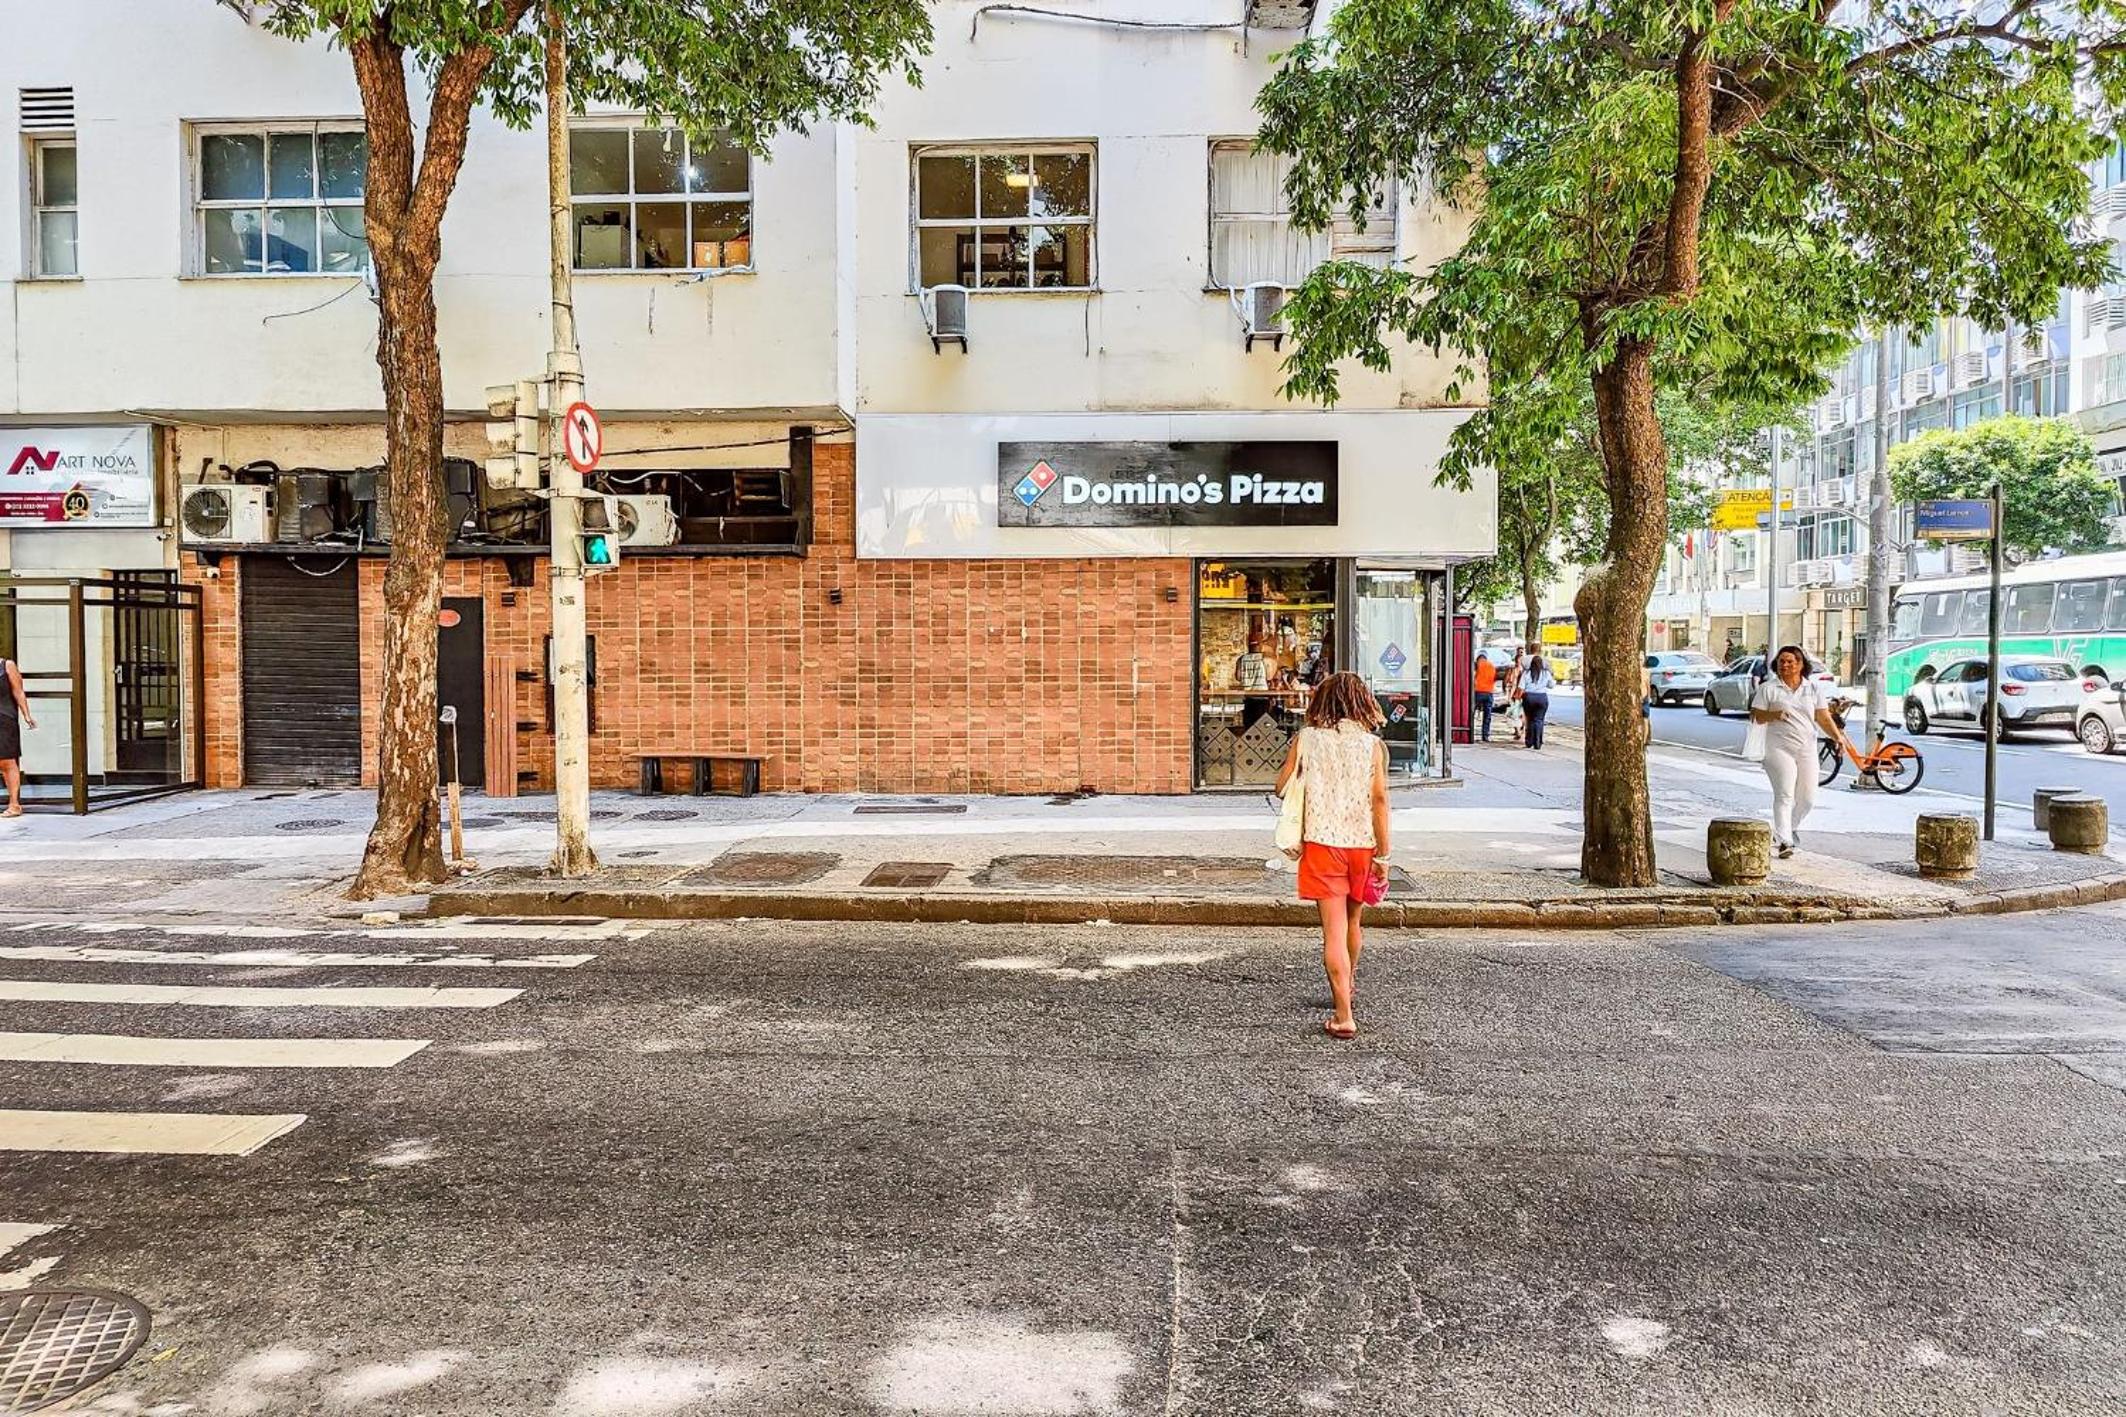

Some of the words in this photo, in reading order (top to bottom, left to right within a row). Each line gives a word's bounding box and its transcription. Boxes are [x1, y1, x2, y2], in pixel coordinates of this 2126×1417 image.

[57, 456, 84, 468] ART
[93, 456, 136, 469] NOVA
[1063, 474, 1223, 504] Domino's
[1230, 473, 1325, 504] Pizza
